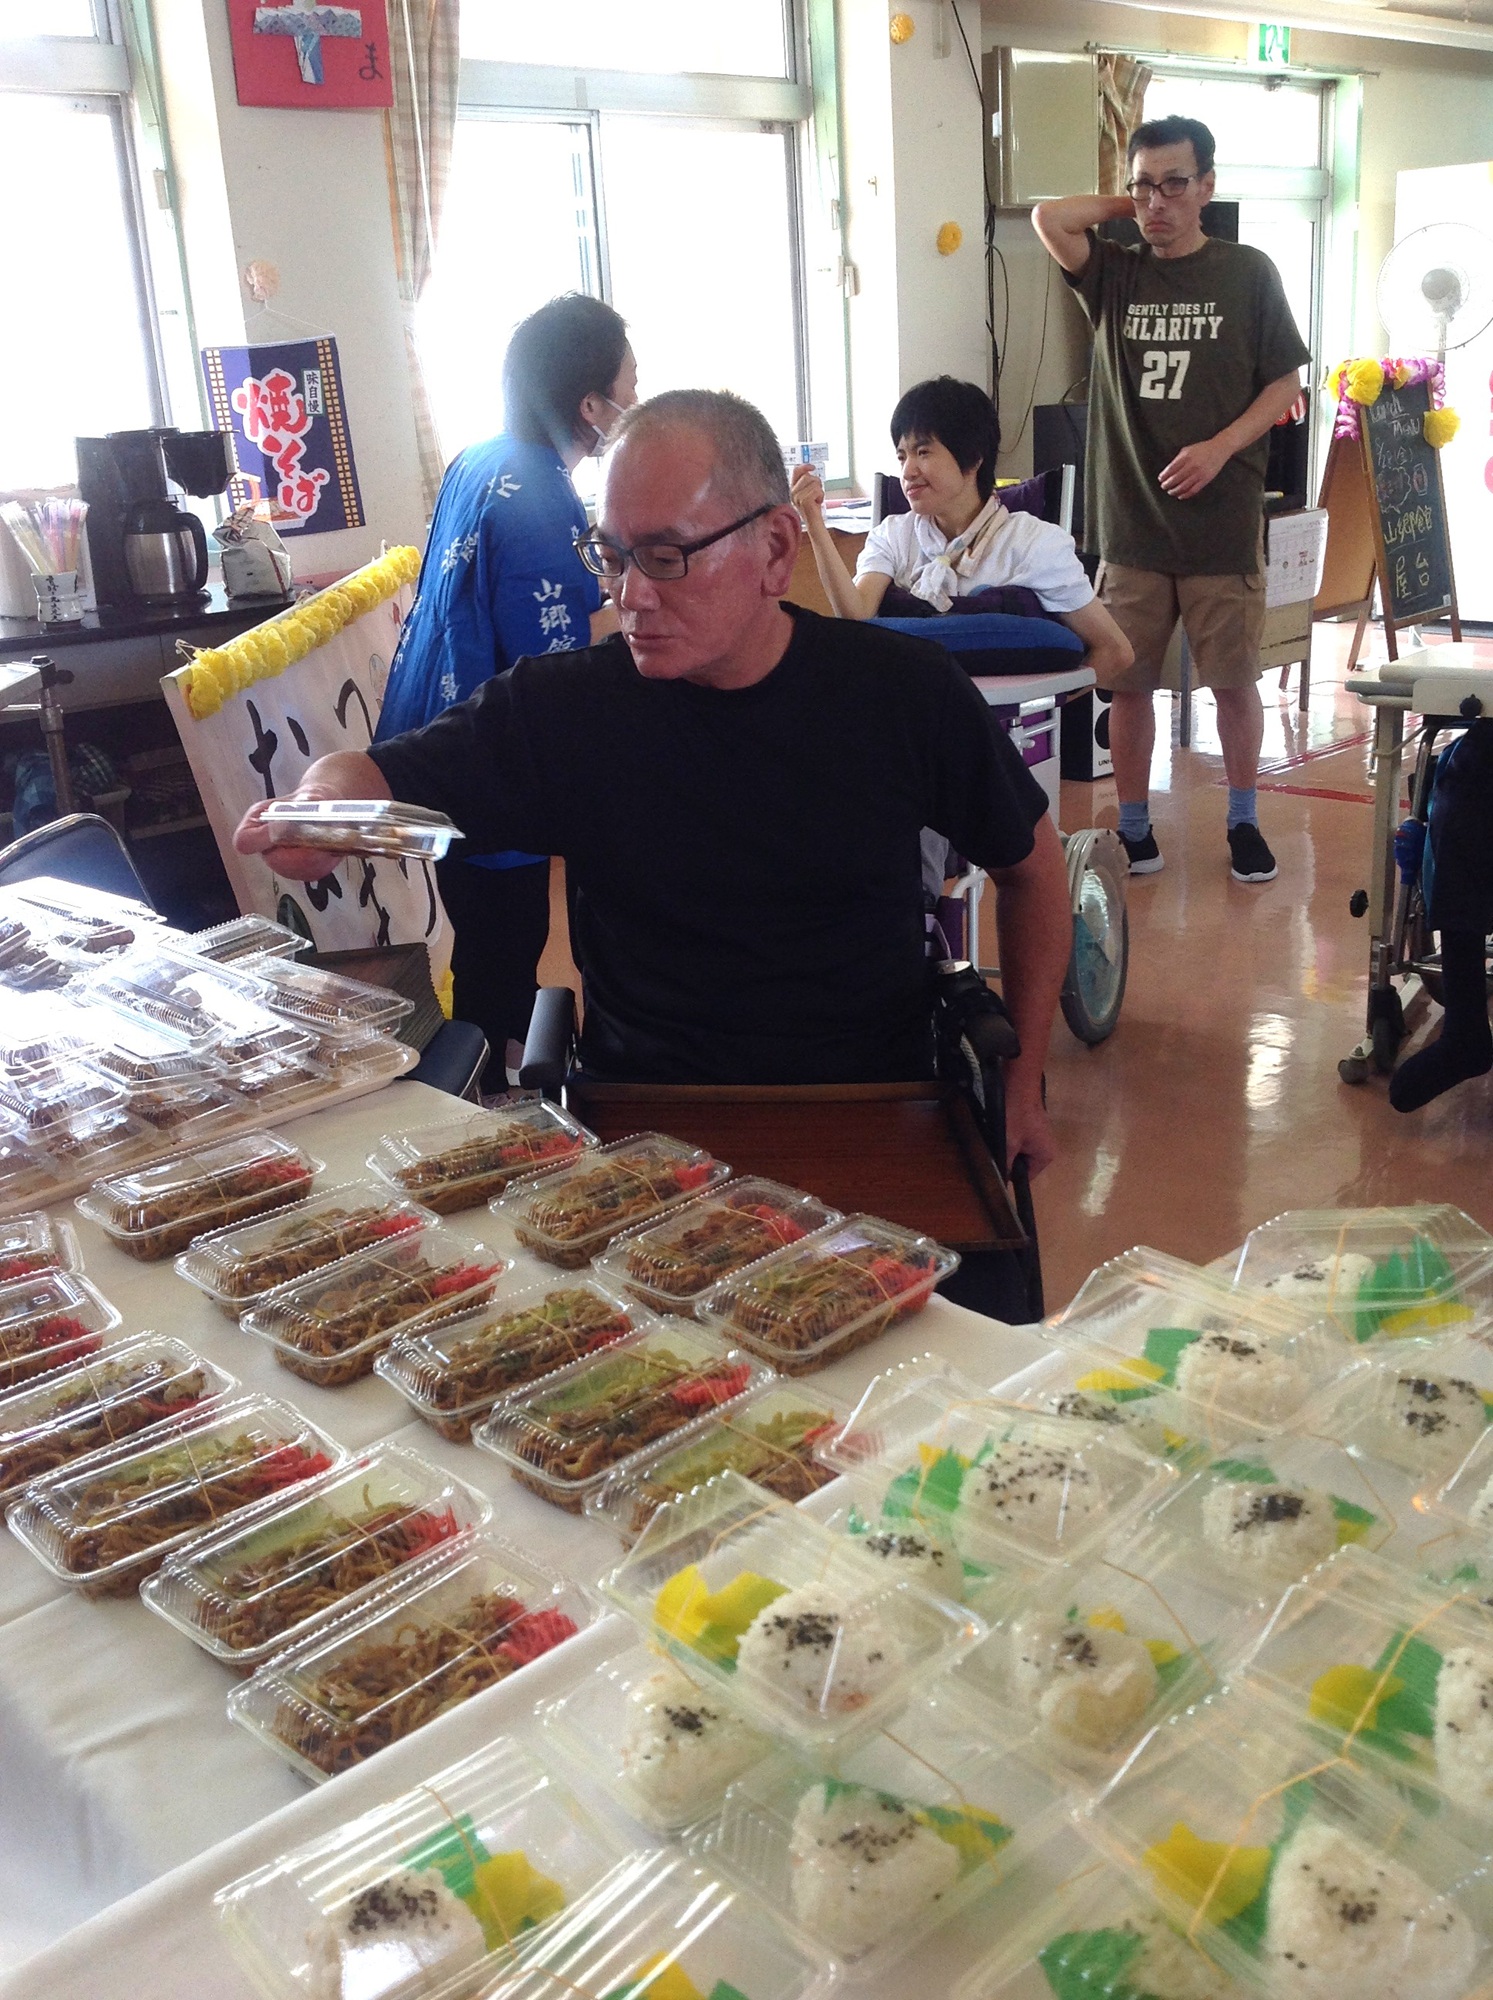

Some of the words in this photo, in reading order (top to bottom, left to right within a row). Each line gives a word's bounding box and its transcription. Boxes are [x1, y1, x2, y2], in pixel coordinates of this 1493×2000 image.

[359, 42, 384, 81] ま
[1127, 303, 1169, 316] GENTLY
[1171, 303, 1201, 316] DOES
[1203, 302, 1217, 315] IT
[305, 371, 321, 414] 味自慢
[1139, 350, 1191, 400] 27
[235, 371, 327, 513] 焼そば
